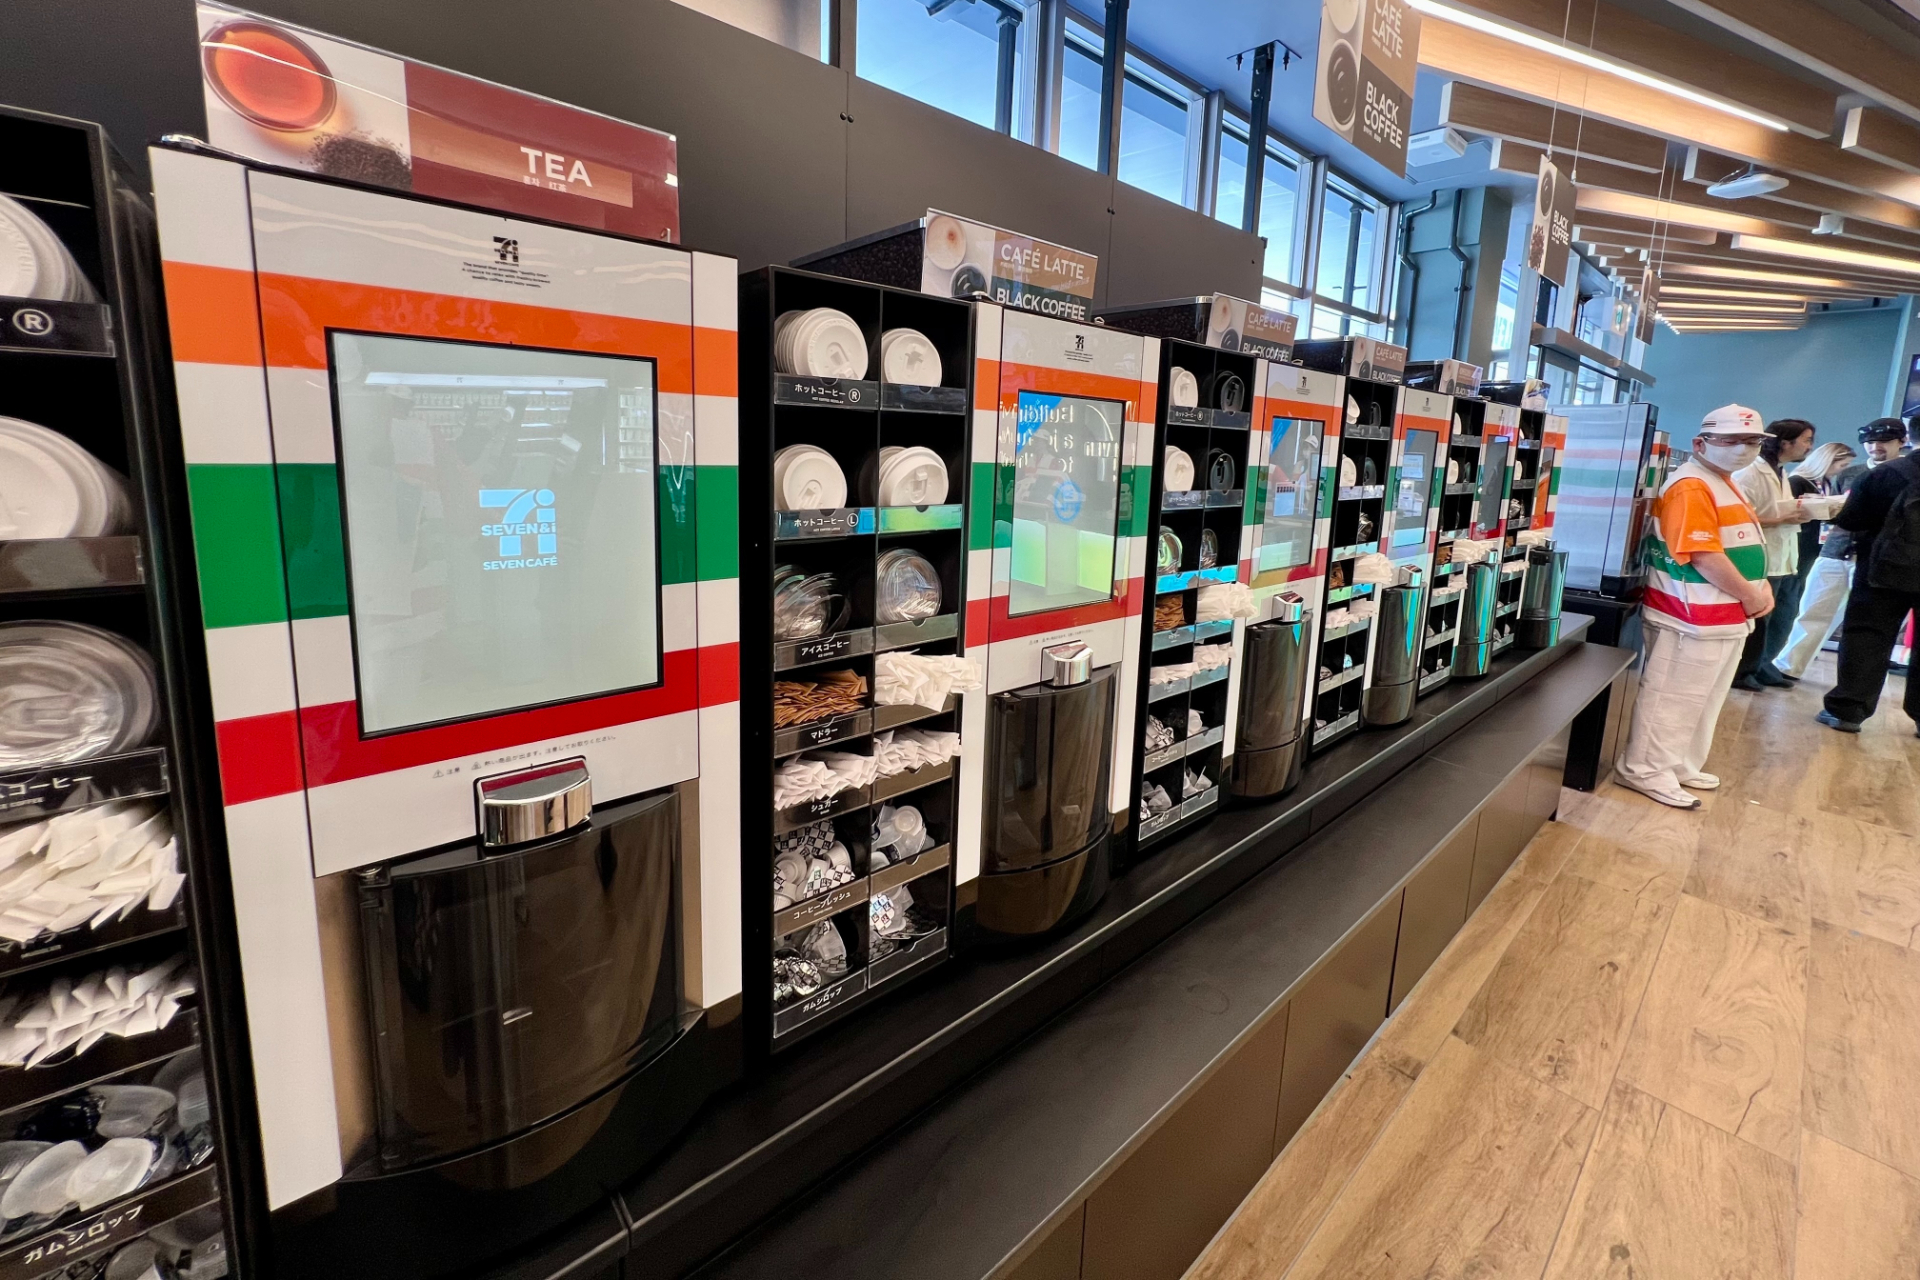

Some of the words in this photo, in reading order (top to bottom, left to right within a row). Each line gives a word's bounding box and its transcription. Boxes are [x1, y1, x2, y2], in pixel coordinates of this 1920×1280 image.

[1375, 0, 1402, 32] CAFÉ
[1372, 13, 1403, 59] LATTE
[1365, 81, 1399, 125] BLACK
[1364, 104, 1403, 149] COFFEE
[520, 146, 593, 188] TEA
[1554, 209, 1569, 231] BLACK
[1552, 223, 1570, 246] COFFEE
[1001, 244, 1041, 269] CAFÉ
[1044, 255, 1085, 280] LATTE
[996, 287, 1041, 312] BLACK
[1041, 298, 1086, 321] COFFEE
[1248, 312, 1269, 328] CAFÉ
[1270, 317, 1292, 333] LATTE
[794, 383, 846, 397] ホットコーヒー
[481, 523, 538, 536] SEVEN
[794, 517, 845, 528] ホットコーヒー
[483, 559, 525, 571] SEVEN
[525, 555, 558, 567] CAFÉ
[801, 641, 850, 656] アイスコーヒー
[810, 728, 838, 739] マドラー
[811, 798, 838, 813] シュガー
[793, 891, 851, 920] コーヒーフレッシュ
[23, 1204, 144, 1264] ガムシロップ
